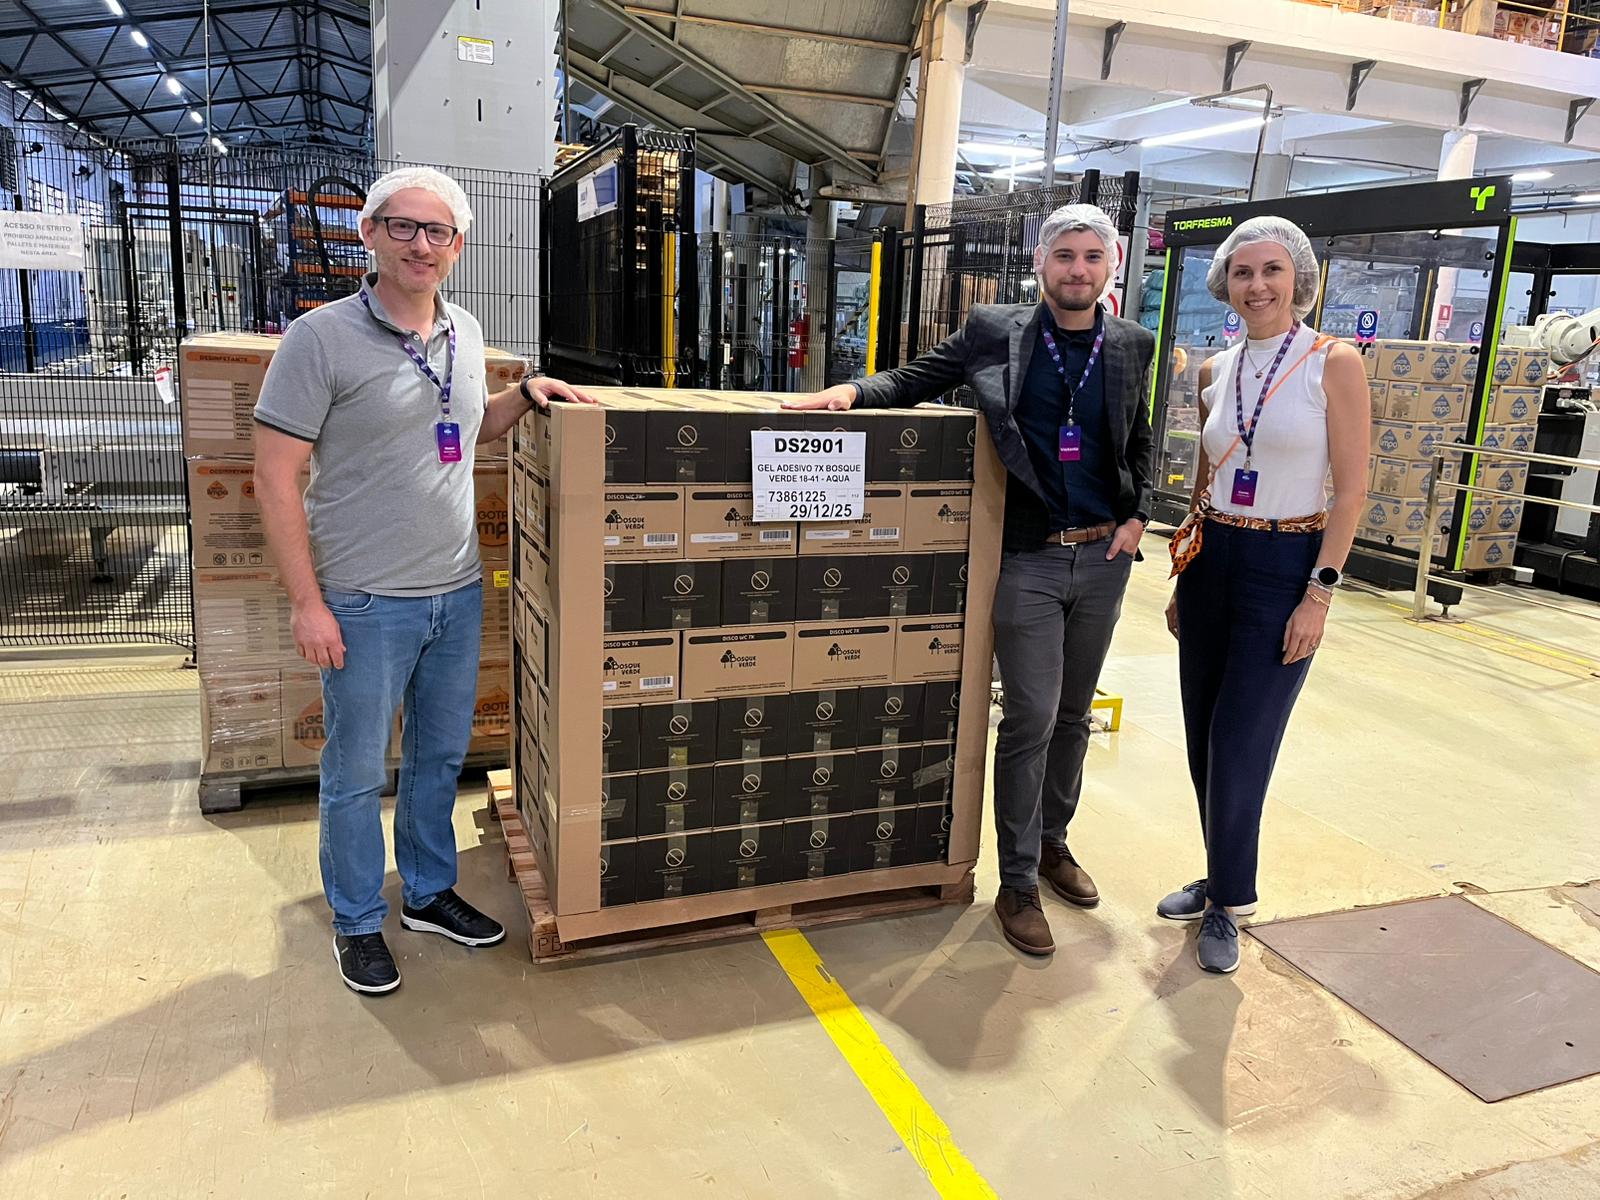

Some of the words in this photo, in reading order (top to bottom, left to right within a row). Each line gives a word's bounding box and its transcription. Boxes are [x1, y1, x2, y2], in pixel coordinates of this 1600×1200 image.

[4, 222, 35, 230] ACESSO
[1173, 216, 1233, 231] TORFRESMA
[774, 438, 843, 454] DS2901
[758, 464, 774, 472] GEL
[826, 464, 861, 473] BOSQUE
[768, 490, 826, 502] 73861225
[790, 504, 852, 518] 29/12/25
[616, 514, 644, 523] BOSQUE
[730, 654, 756, 662] BOSQUE
[306, 715, 324, 724] GO
[294, 722, 324, 740] lim
